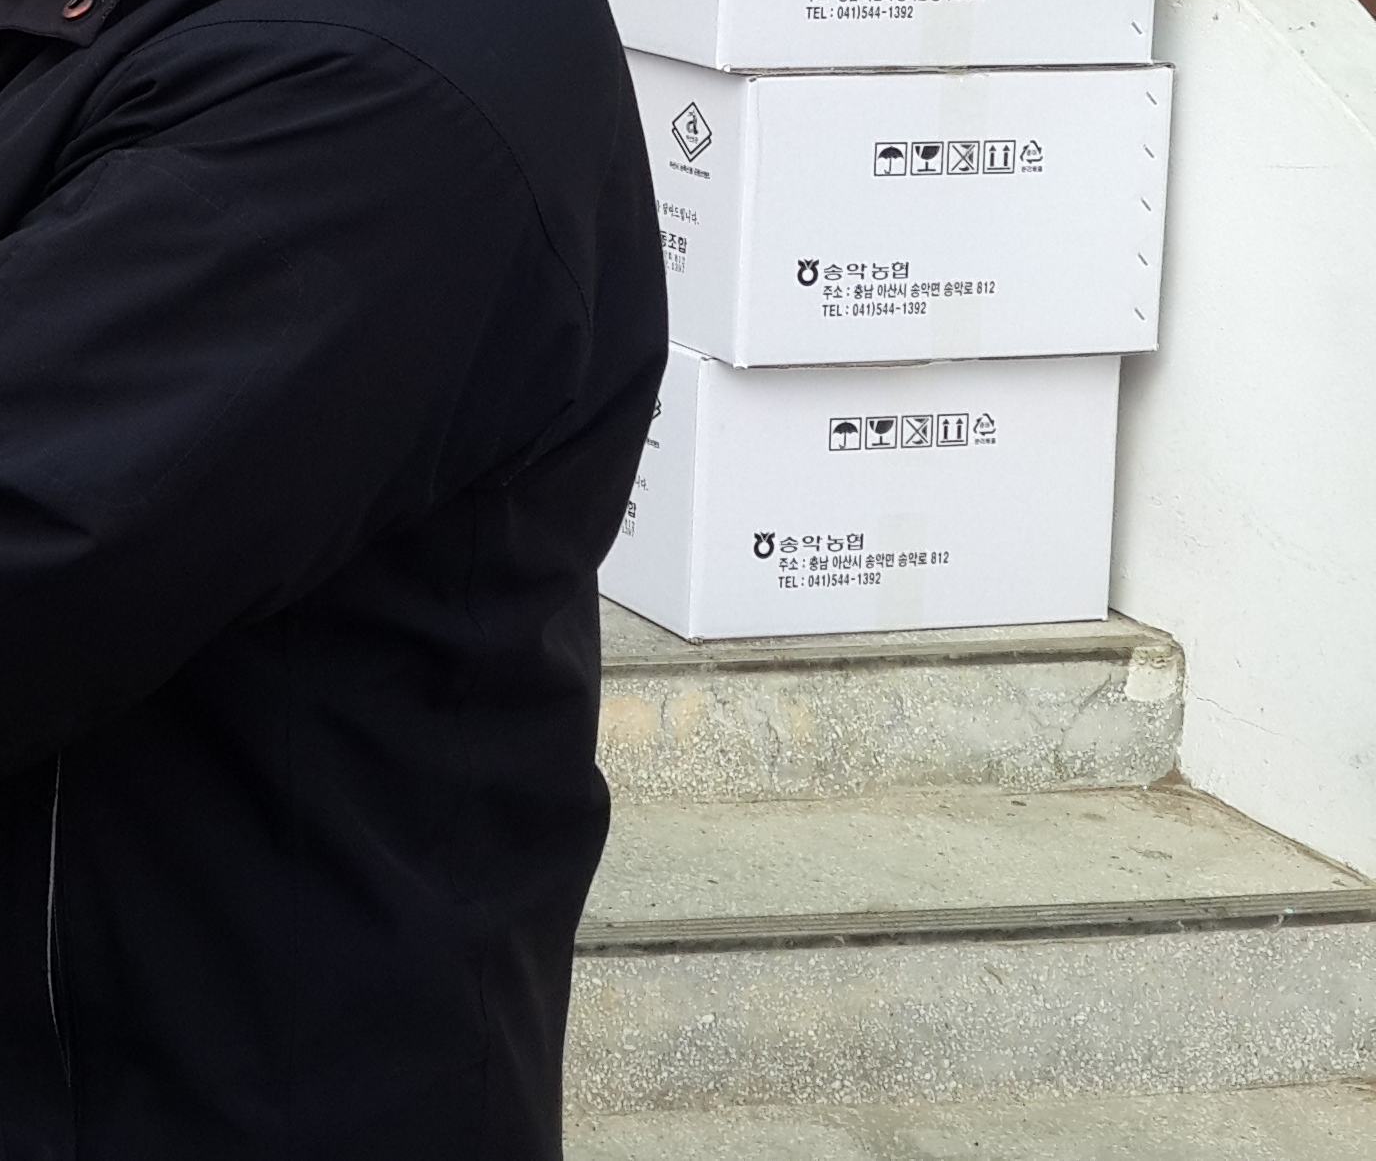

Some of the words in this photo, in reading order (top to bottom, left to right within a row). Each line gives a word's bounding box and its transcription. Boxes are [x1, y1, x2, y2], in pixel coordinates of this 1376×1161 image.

[837, 5, 914, 20] 041)544-1392
[823, 261, 910, 281] 송악농협
[853, 284, 874, 300] 충남
[877, 283, 908, 299] 아산시
[910, 282, 941, 298] 송악면
[943, 281, 974, 297] 송악로
[976, 280, 996, 295] 812
[852, 302, 928, 317] 041)544-1392
[779, 533, 865, 554] 송악농협
[809, 555, 830, 571] 충남
[832, 554, 862, 570] 아산시
[865, 553, 896, 569] 송악면
[898, 552, 928, 568] 송악로
[930, 550, 950, 565] 812
[808, 572, 882, 588] 041)544-1392
